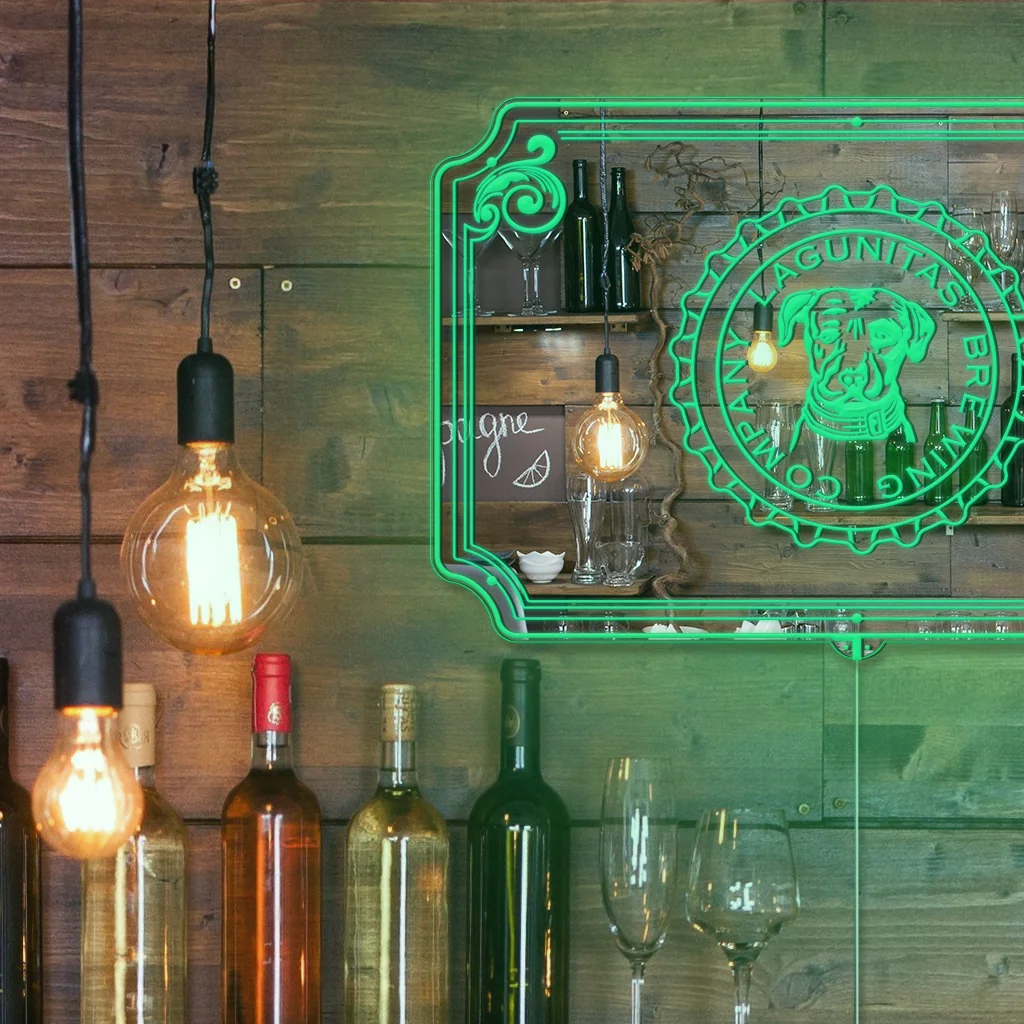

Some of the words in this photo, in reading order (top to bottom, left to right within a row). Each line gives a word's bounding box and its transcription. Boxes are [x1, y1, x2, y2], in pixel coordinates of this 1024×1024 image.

[748, 236, 967, 308] LAGUNITAS
[723, 328, 842, 500] COMPANY
[878, 333, 990, 500] BREWING
